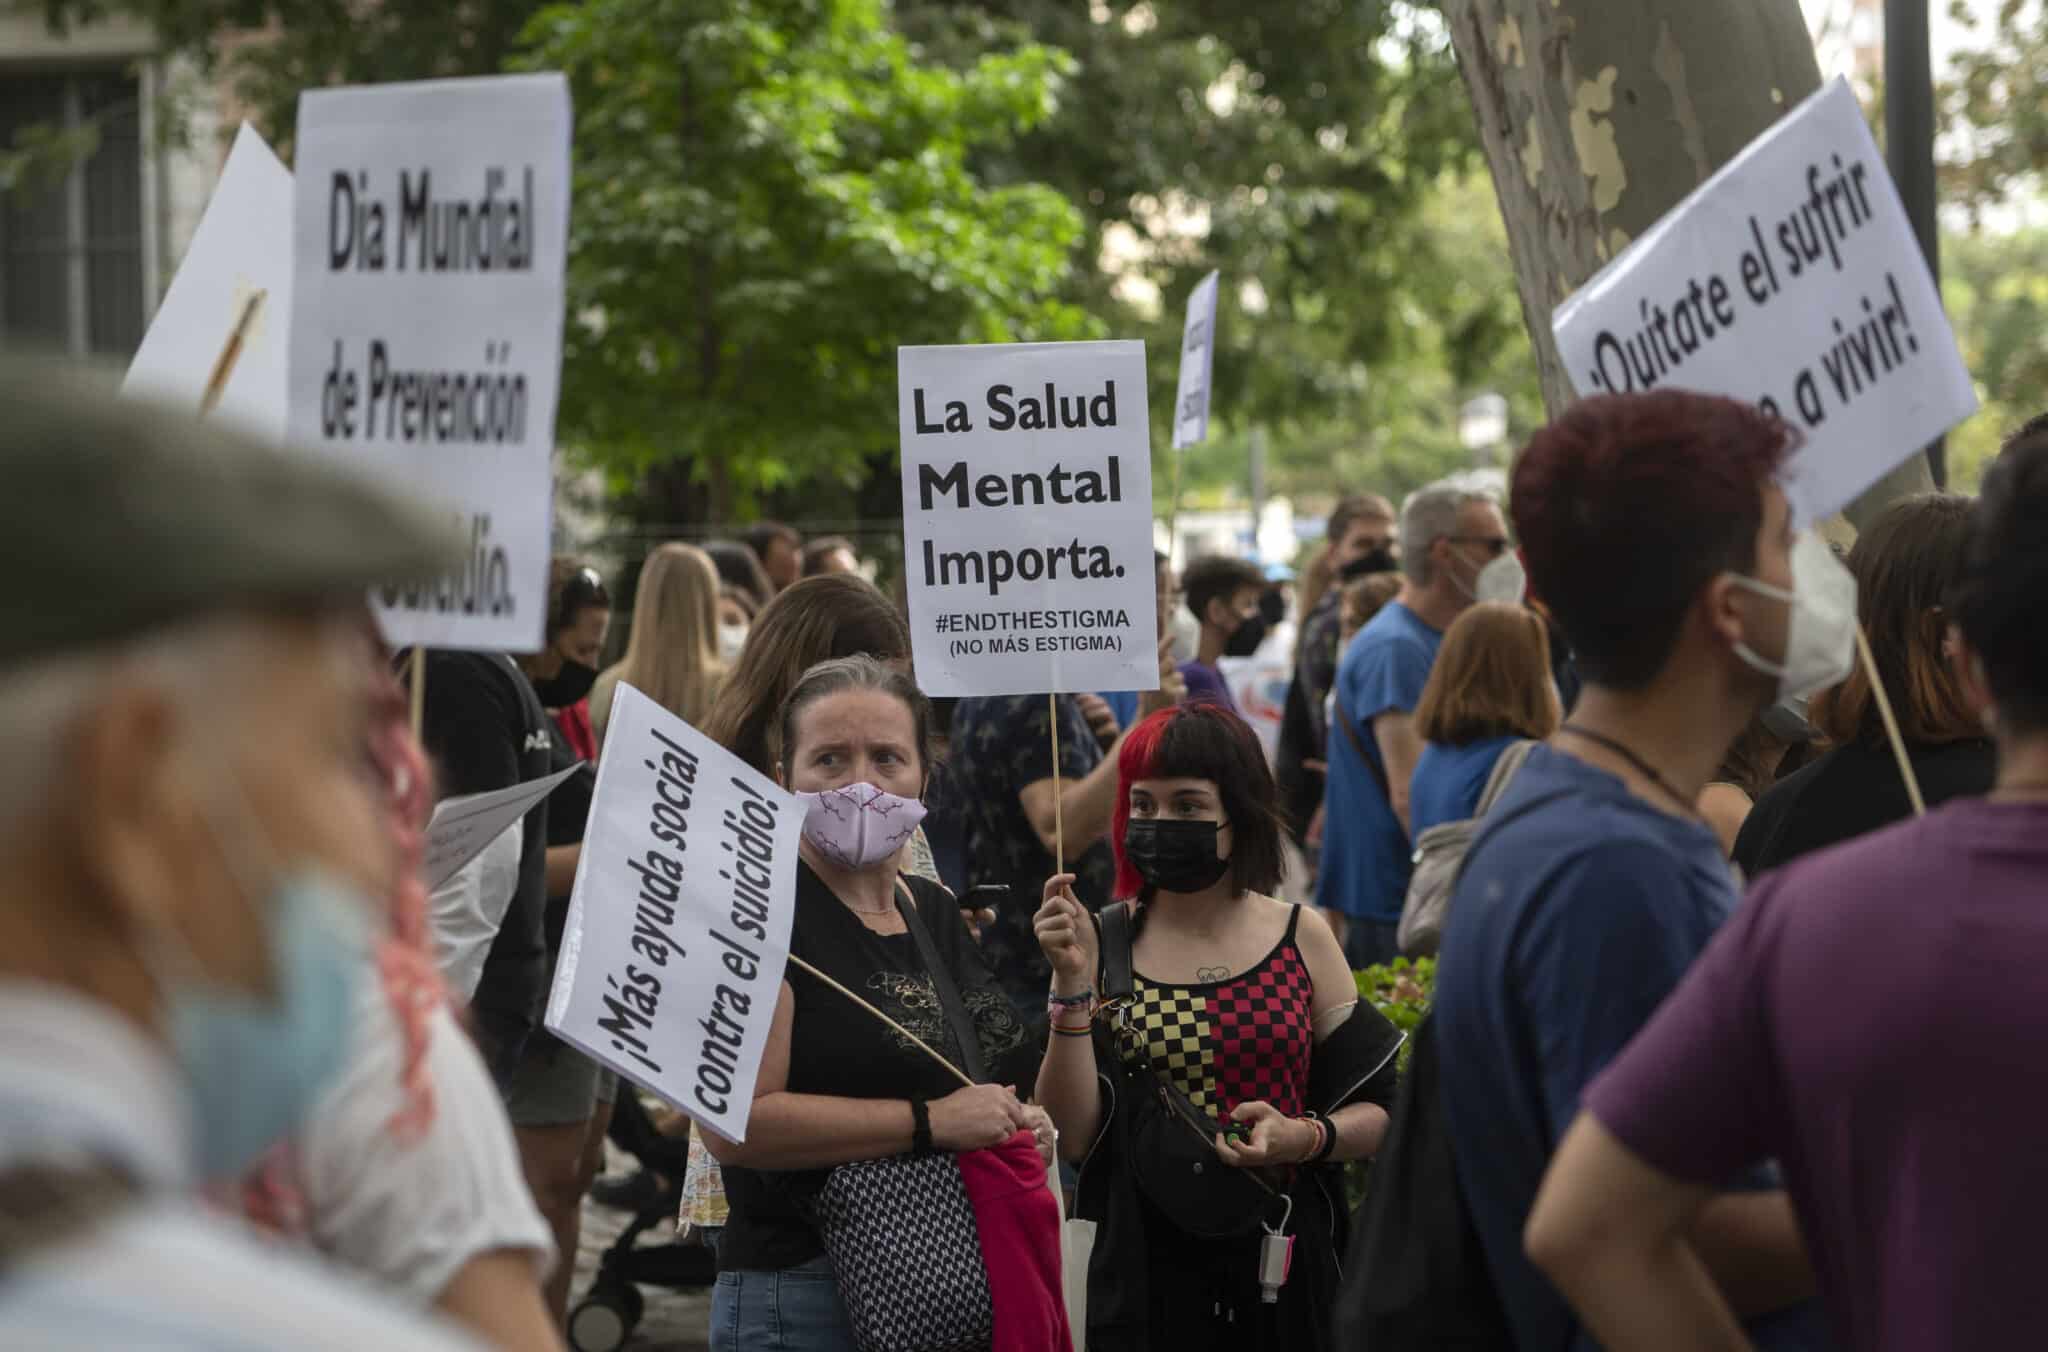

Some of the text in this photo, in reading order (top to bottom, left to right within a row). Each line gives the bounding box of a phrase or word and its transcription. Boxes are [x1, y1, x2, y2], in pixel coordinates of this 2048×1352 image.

[398, 168, 533, 272] Mundial
[1590, 152, 1873, 393] Quítate el sufrir
[322, 338, 527, 444] de Prevención
[1794, 271, 1918, 428] a vivir!
[914, 380, 1117, 435] La Salud
[918, 456, 1122, 511] Mental
[923, 538, 1125, 596] Importa.
[936, 610, 1131, 633] #ENDTHESTIGMA
[950, 634, 1123, 658] (NO MÁS ESTIGMA)
[597, 727, 699, 1074] ¡Más ayuda social
[694, 776, 780, 1116] contra el suicidio!
